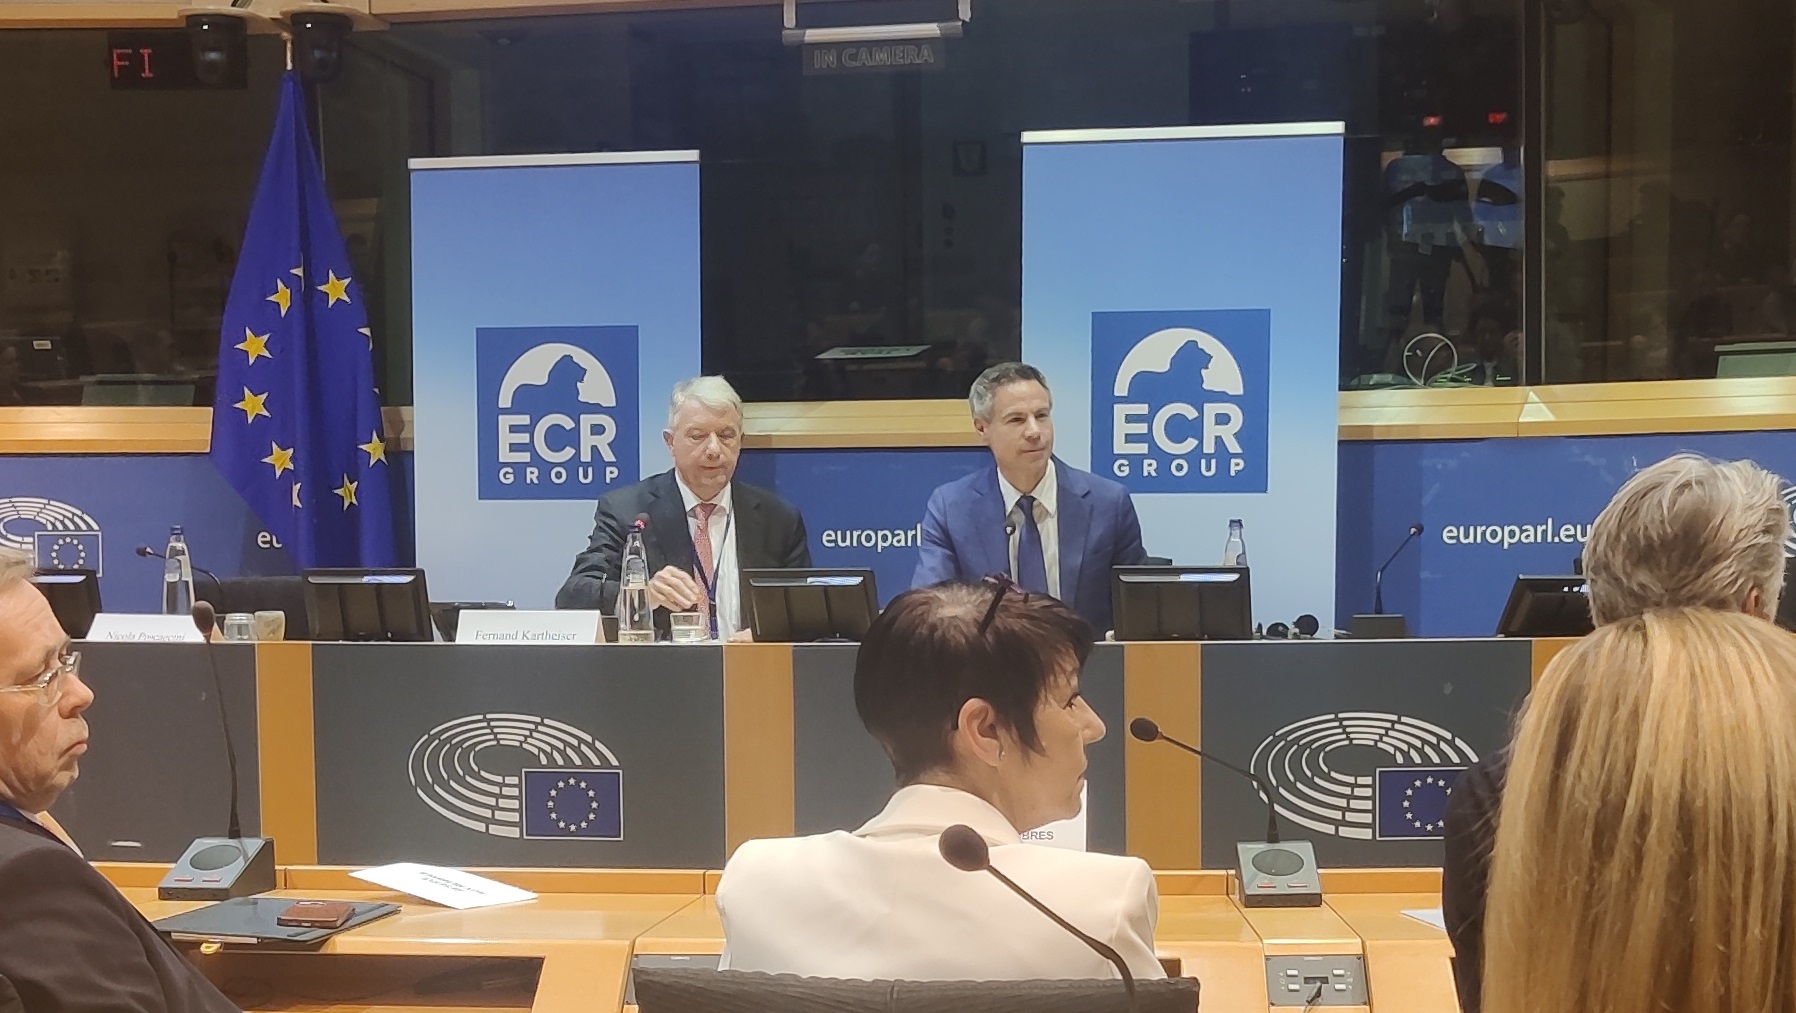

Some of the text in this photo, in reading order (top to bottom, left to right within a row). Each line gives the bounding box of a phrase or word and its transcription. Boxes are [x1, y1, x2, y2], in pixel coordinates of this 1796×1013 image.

[113, 49, 153, 77] FI
[814, 44, 934, 68] IN CAMERA
[498, 413, 617, 462] ECR
[1113, 403, 1243, 454] ECR
[499, 466, 619, 484] GROUP
[1113, 458, 1244, 477] GROUP
[822, 523, 921, 552] europarl
[475, 630, 518, 640] Fernand
